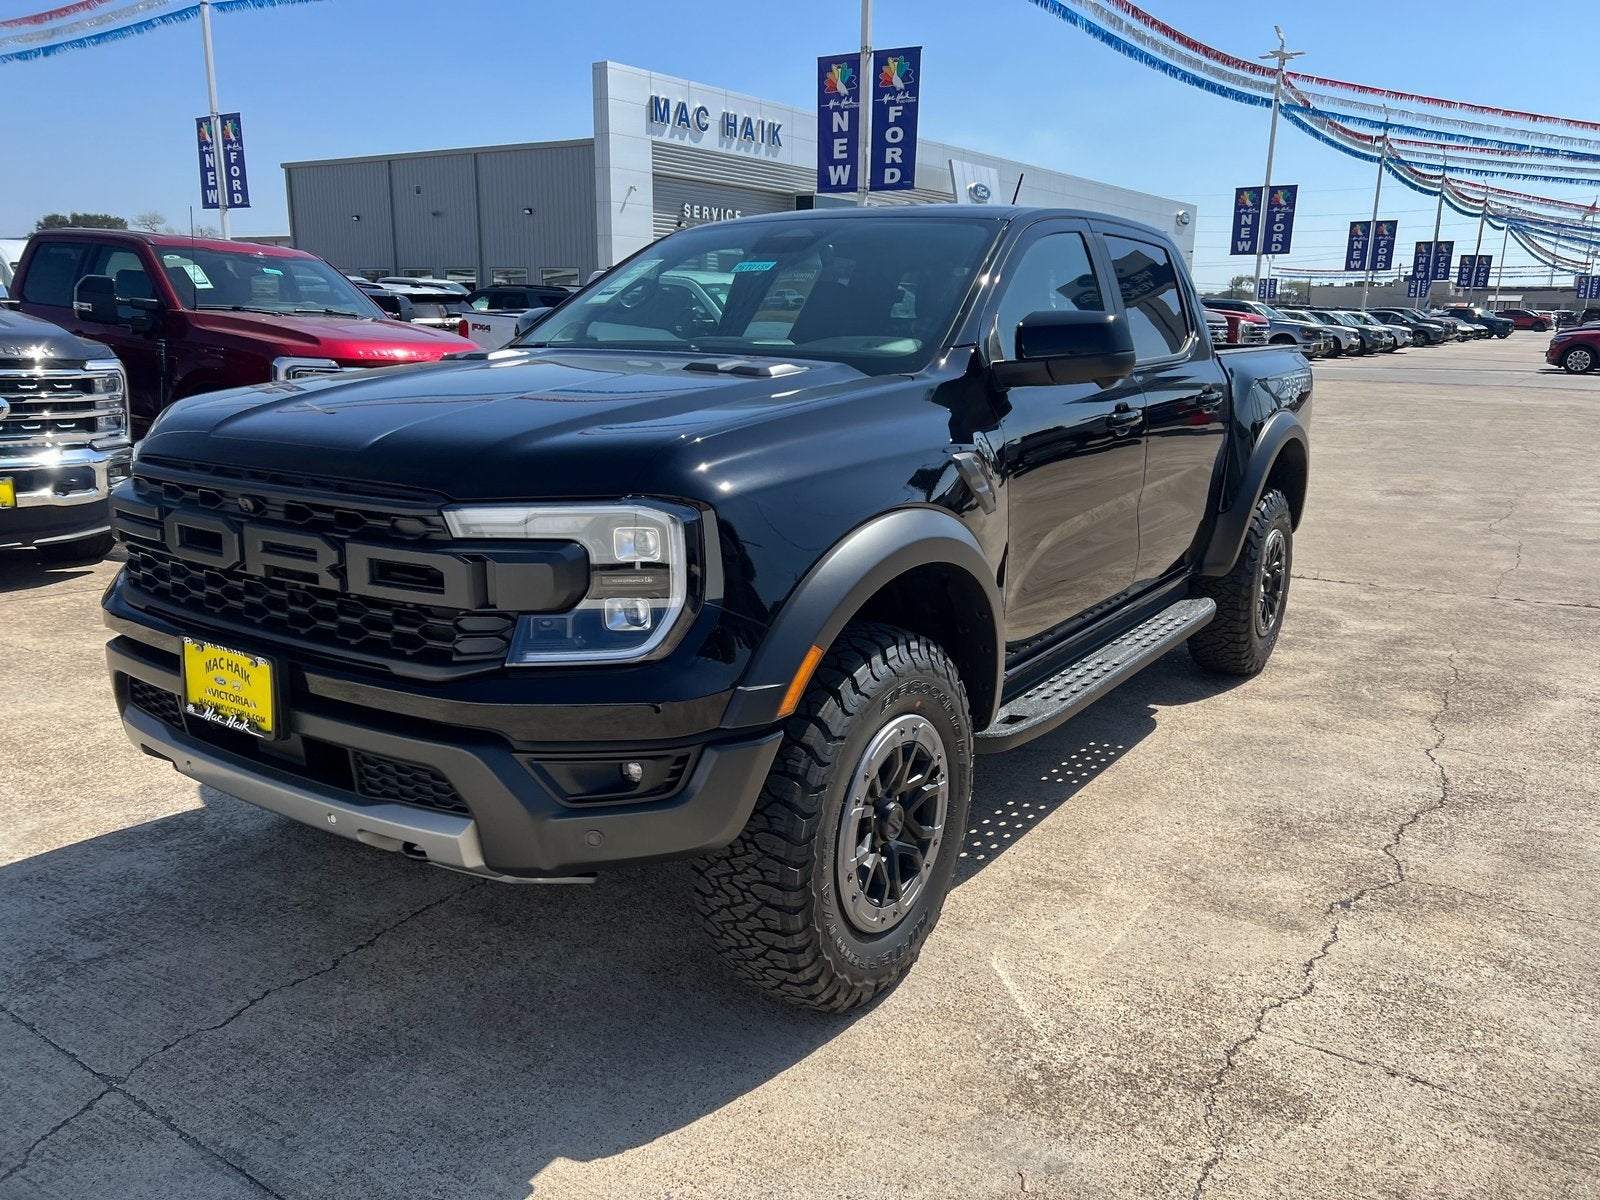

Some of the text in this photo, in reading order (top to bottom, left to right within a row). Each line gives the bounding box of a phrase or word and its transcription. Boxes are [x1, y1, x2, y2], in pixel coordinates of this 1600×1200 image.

[651, 95, 782, 148] MAC HAIK
[828, 110, 851, 186] NEW
[883, 105, 904, 184] FORD
[205, 153, 218, 204] NEW
[230, 152, 243, 204] FORD
[683, 202, 742, 221] SERVICE
[1236, 214, 1253, 252] NEW
[1270, 213, 1285, 252] FORD
[1349, 240, 1363, 269] NEW
[1376, 240, 1388, 269] FORD
[1415, 257, 1426, 279] NEW
[1437, 256, 1446, 279] FORD
[1460, 267, 1469, 286] NEW
[1477, 268, 1486, 286] FORD
[471, 323, 491, 332] FX4
[112, 505, 475, 613] FORD
[205, 657, 252, 687] MAC HAIK
[210, 687, 250, 708] VICTORIA
[203, 707, 224, 721] Mac
